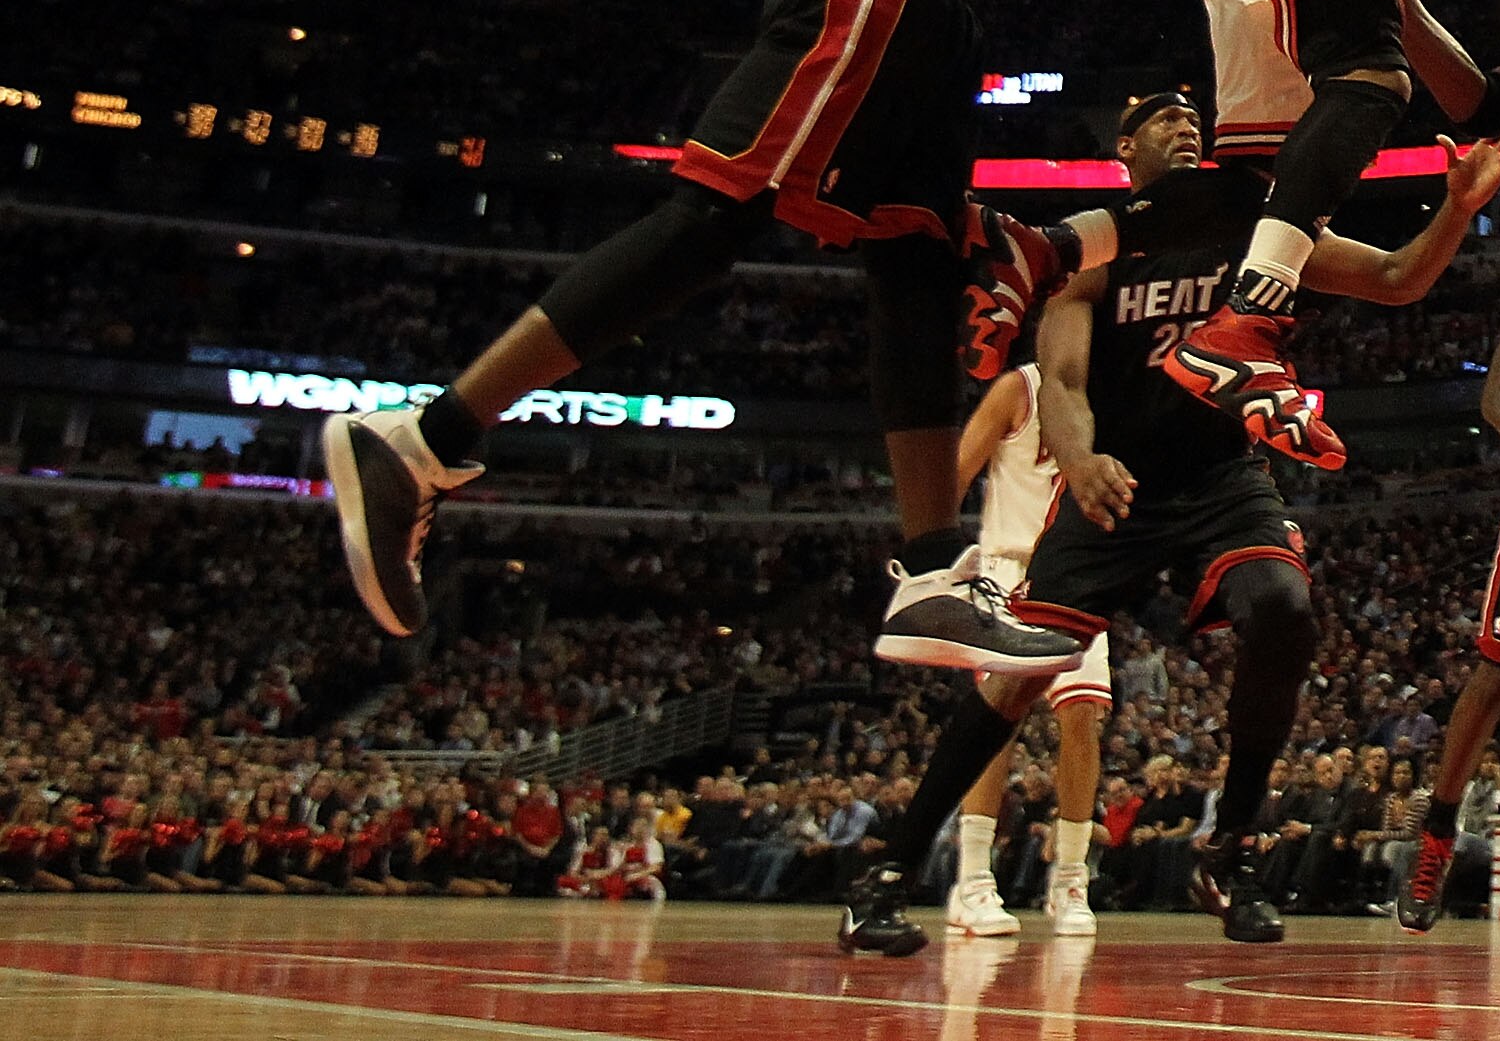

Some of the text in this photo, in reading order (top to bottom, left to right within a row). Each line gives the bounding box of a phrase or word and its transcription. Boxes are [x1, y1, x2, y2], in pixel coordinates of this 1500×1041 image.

[1117, 262, 1229, 324] HEAT
[228, 368, 379, 413] WGN
[642, 394, 736, 429] HD
